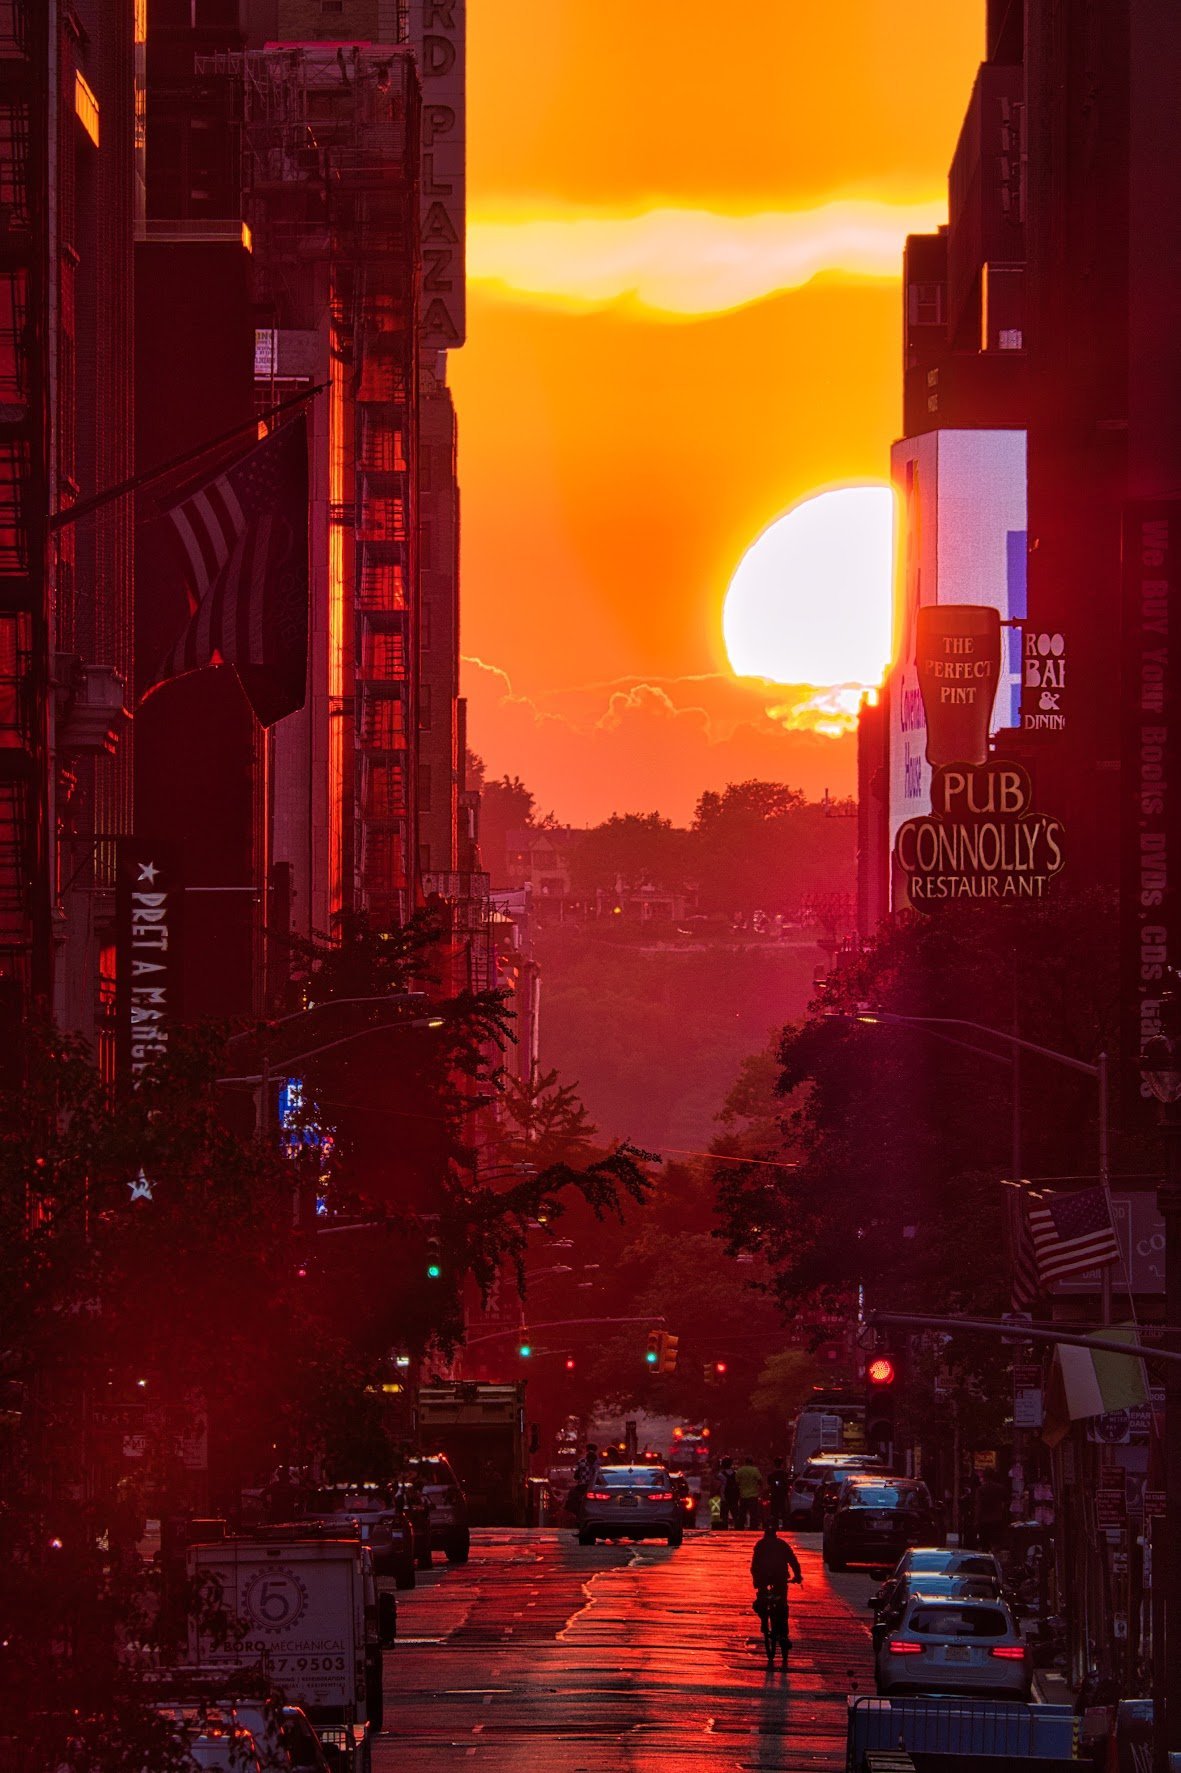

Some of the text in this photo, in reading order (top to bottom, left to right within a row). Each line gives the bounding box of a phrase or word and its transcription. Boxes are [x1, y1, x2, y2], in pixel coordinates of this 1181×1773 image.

[420, 104, 460, 340] PLAZA
[1142, 519, 1169, 567] We
[1142, 579, 1169, 635] BUY
[943, 637, 974, 654] THE
[1025, 632, 1066, 656] ROO
[927, 659, 993, 679] PERFECT
[1141, 647, 1169, 714] Your
[939, 687, 977, 705] PINT
[1038, 690, 1061, 711] &
[943, 771, 1025, 813] PUB
[897, 817, 1063, 872] CONNOLLY'S
[911, 876, 1047, 898] RESTAURANT
[130, 892, 168, 951] PRET
[131, 959, 168, 976] A
[260, 1581, 289, 1621] 5
[223, 1640, 266, 1652] BORO
[270, 1639, 346, 1652] MECHANICAL
